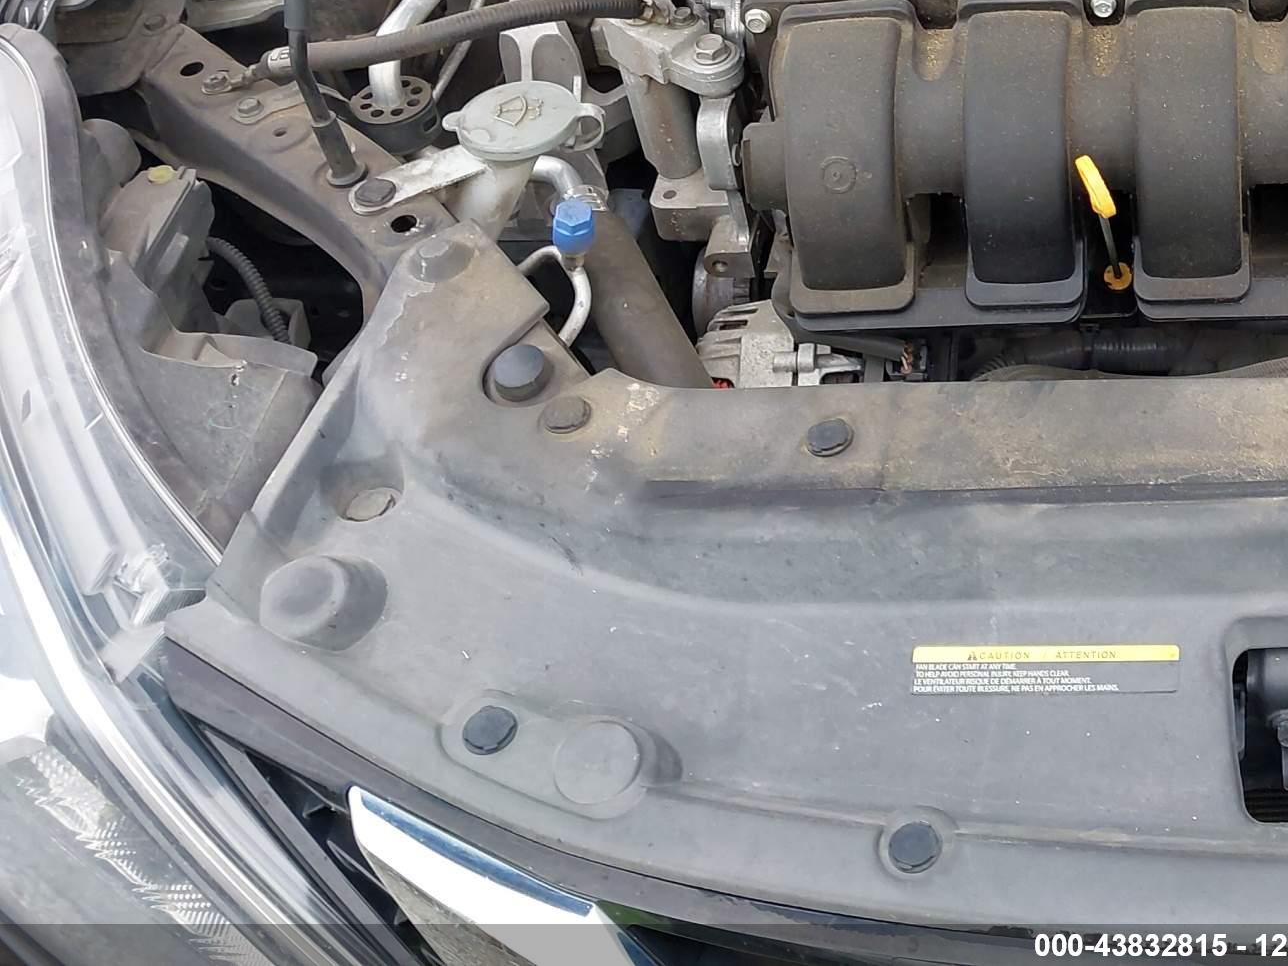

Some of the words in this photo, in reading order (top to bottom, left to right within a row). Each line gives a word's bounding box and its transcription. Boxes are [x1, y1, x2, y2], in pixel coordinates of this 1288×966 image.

[979, 651, 1030, 660] CAUTION
[1055, 650, 1117, 659] ATTENTION
[913, 685, 932, 693] POUR
[956, 685, 976, 693] TOUTE
[1021, 684, 1033, 692] PAS
[1035, 684, 1043, 692] EN
[1044, 684, 1083, 692] APPROCHER
